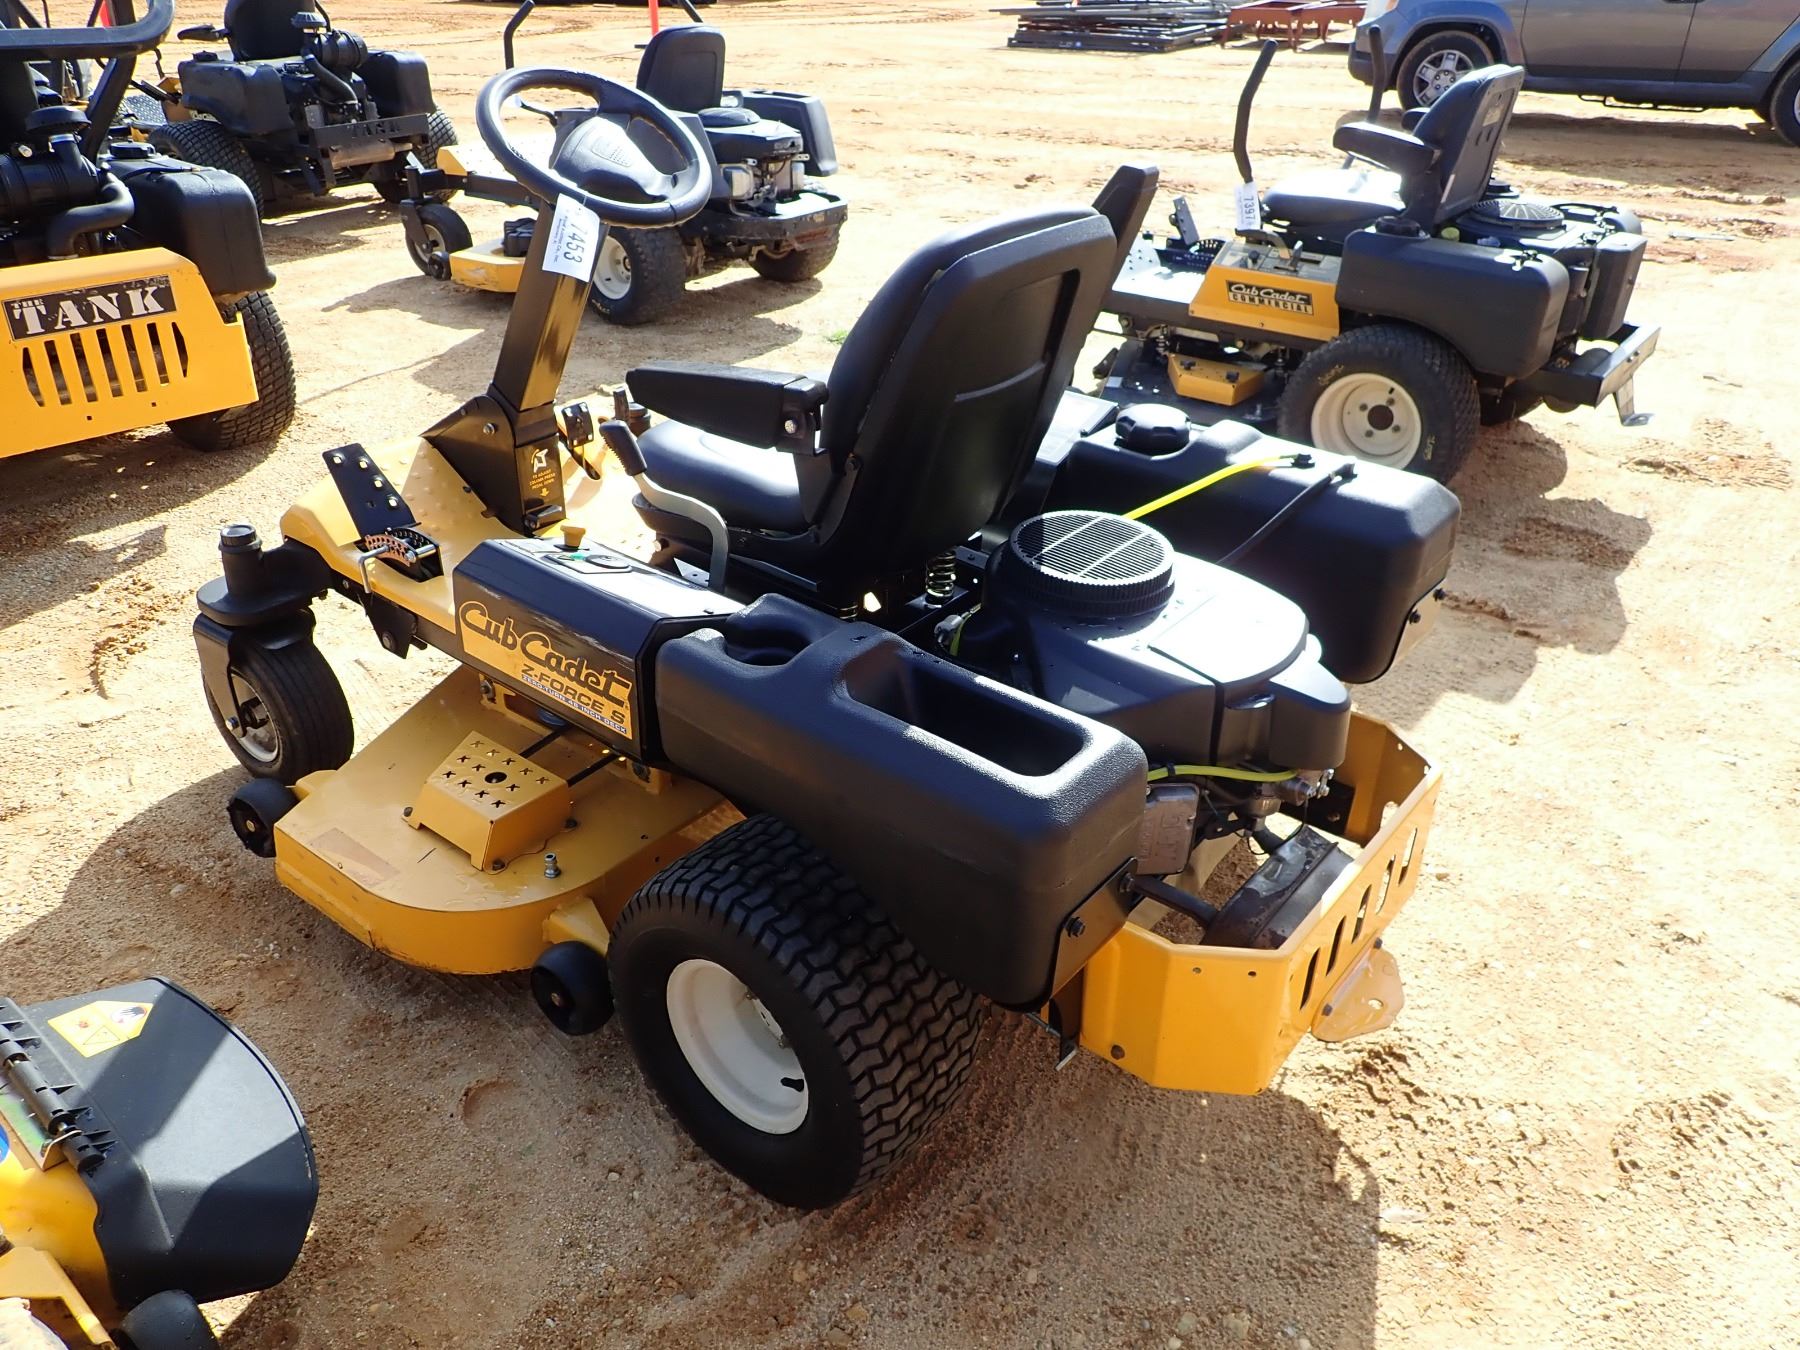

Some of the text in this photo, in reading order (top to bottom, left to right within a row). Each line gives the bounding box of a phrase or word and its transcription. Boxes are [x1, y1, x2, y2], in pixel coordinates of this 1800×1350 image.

[563, 223, 588, 263] 7453
[11, 298, 44, 309] THE
[12, 286, 165, 335] TANK
[1231, 284, 1308, 304] Cub Cadet
[1232, 293, 1309, 313] COMMERCIAL
[459, 601, 632, 709] Cub Cadet
[521, 663, 625, 725] Z-FORCE S
[522, 674, 566, 702] ZERO-TURN
[581, 706, 601, 721] INCH
[604, 717, 627, 734] DECK
